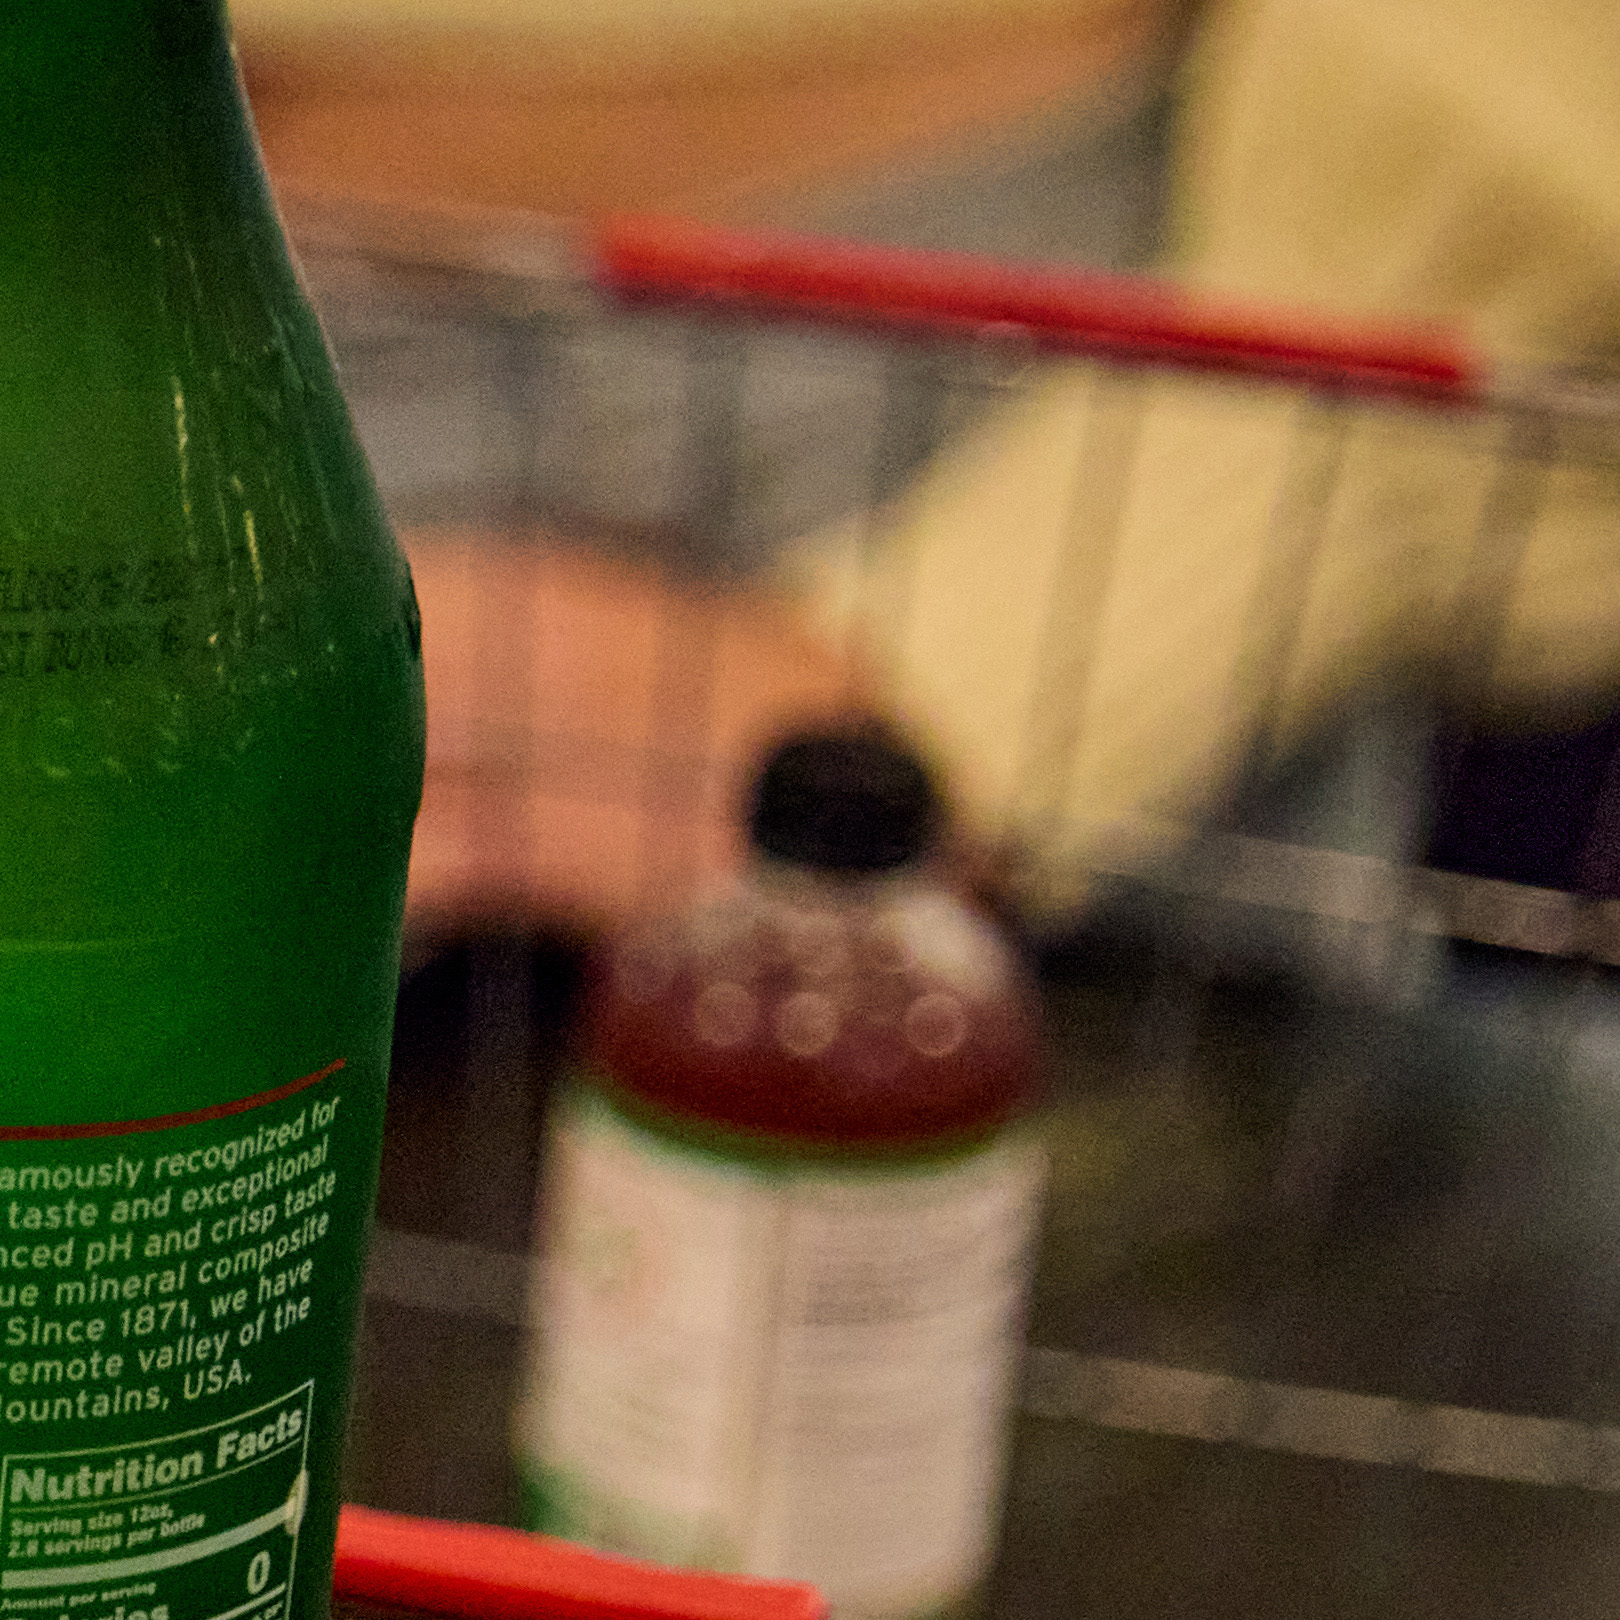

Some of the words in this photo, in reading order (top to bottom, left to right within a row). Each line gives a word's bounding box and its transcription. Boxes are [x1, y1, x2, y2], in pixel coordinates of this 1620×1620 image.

[154, 1109, 306, 1180] recognized
[311, 1096, 340, 1131] for
[9, 1198, 98, 1230] taste
[111, 1186, 171, 1224] and
[181, 1133, 328, 1213] exceptional
[85, 1232, 133, 1271] pH
[144, 1218, 202, 1258] and
[210, 1203, 277, 1244] crisp
[284, 1170, 336, 1218] taste
[55, 1261, 187, 1305] mineral
[198, 1212, 329, 1284] composite
[6, 1316, 106, 1346] Since
[121, 1299, 196, 1338] 1871,
[210, 1288, 248, 1319] we
[258, 1258, 313, 1303] have
[138, 1329, 229, 1373] valley
[239, 1309, 266, 1347] of
[273, 1296, 311, 1334] the
[184, 1359, 252, 1400] USA.
[10, 1451, 203, 1504] Nutrition
[216, 1408, 303, 1469] Facts
[12, 1516, 82, 1537] Serving
[87, 1510, 124, 1531] size
[44, 1532, 122, 1556] servings
[126, 1527, 157, 1549] per
[160, 1512, 206, 1538] bottle
[246, 1550, 271, 1595] 0
